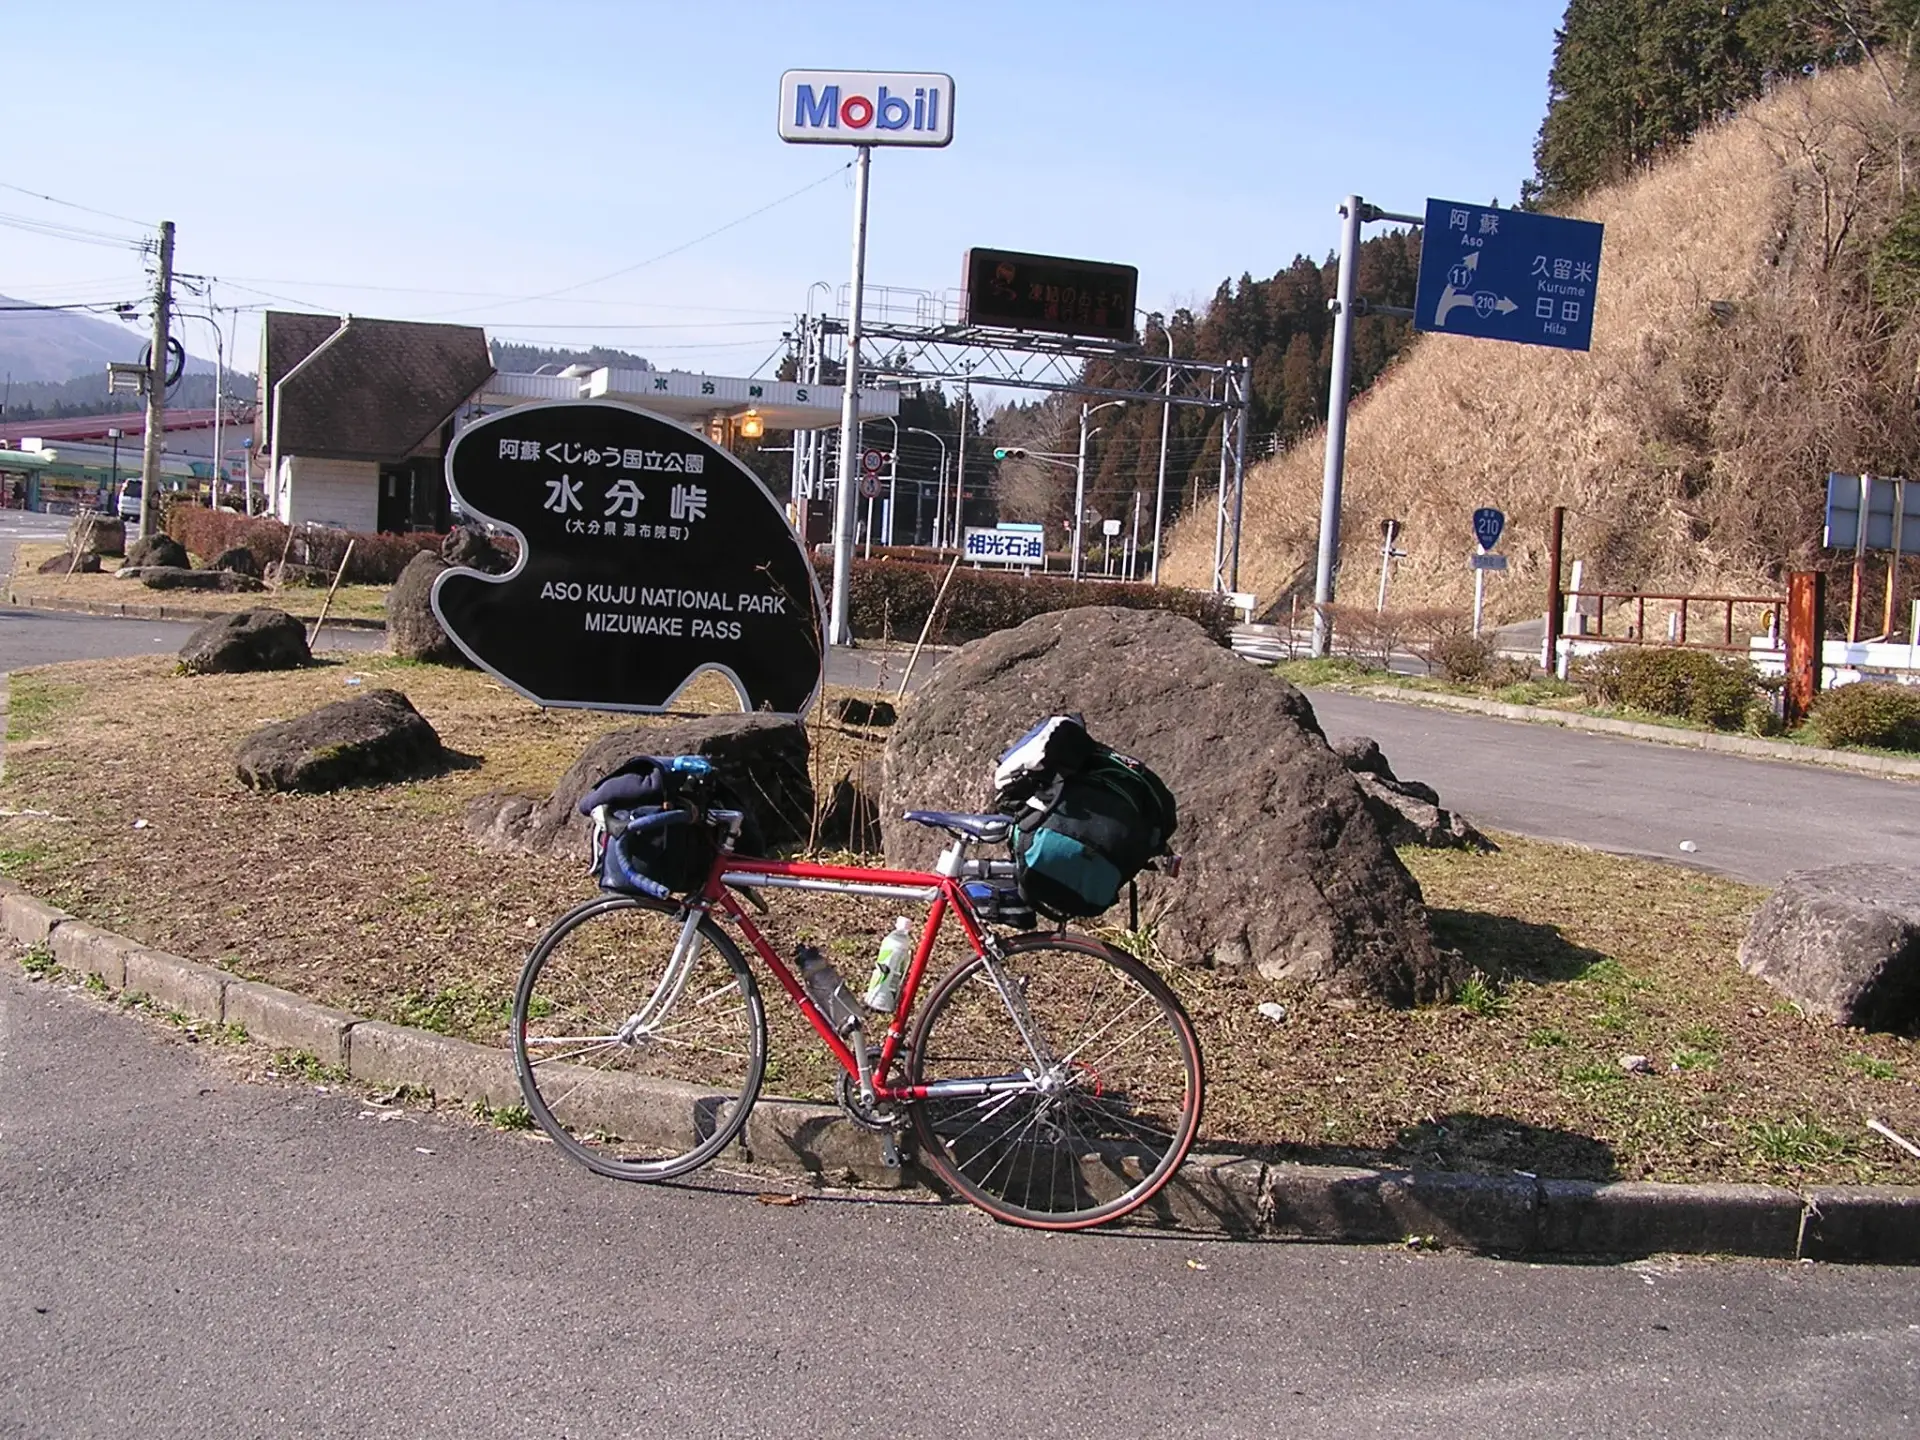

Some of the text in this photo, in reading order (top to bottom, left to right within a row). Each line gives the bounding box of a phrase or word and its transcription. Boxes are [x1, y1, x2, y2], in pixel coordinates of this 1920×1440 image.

[795, 84, 938, 130] Mobil
[1450, 208, 1500, 235] 阿蘇
[1461, 234, 1484, 247] Aso
[1453, 268, 1467, 285] 11
[1531, 255, 1592, 282] 久留米
[1537, 280, 1585, 297] Kurume
[1476, 295, 1495, 309] 210
[1535, 296, 1580, 322] 日田
[1543, 322, 1567, 335] Hita
[499, 439, 704, 474] 阿蘇くじゅう国立公園
[543, 474, 707, 522] 水分峠
[1478, 518, 1500, 536] 210
[967, 533, 1042, 558] 相光石油
[540, 581, 786, 615] ASO KUJU NATIONAL PARK
[584, 612, 742, 640] MIZUWAKE PASS
